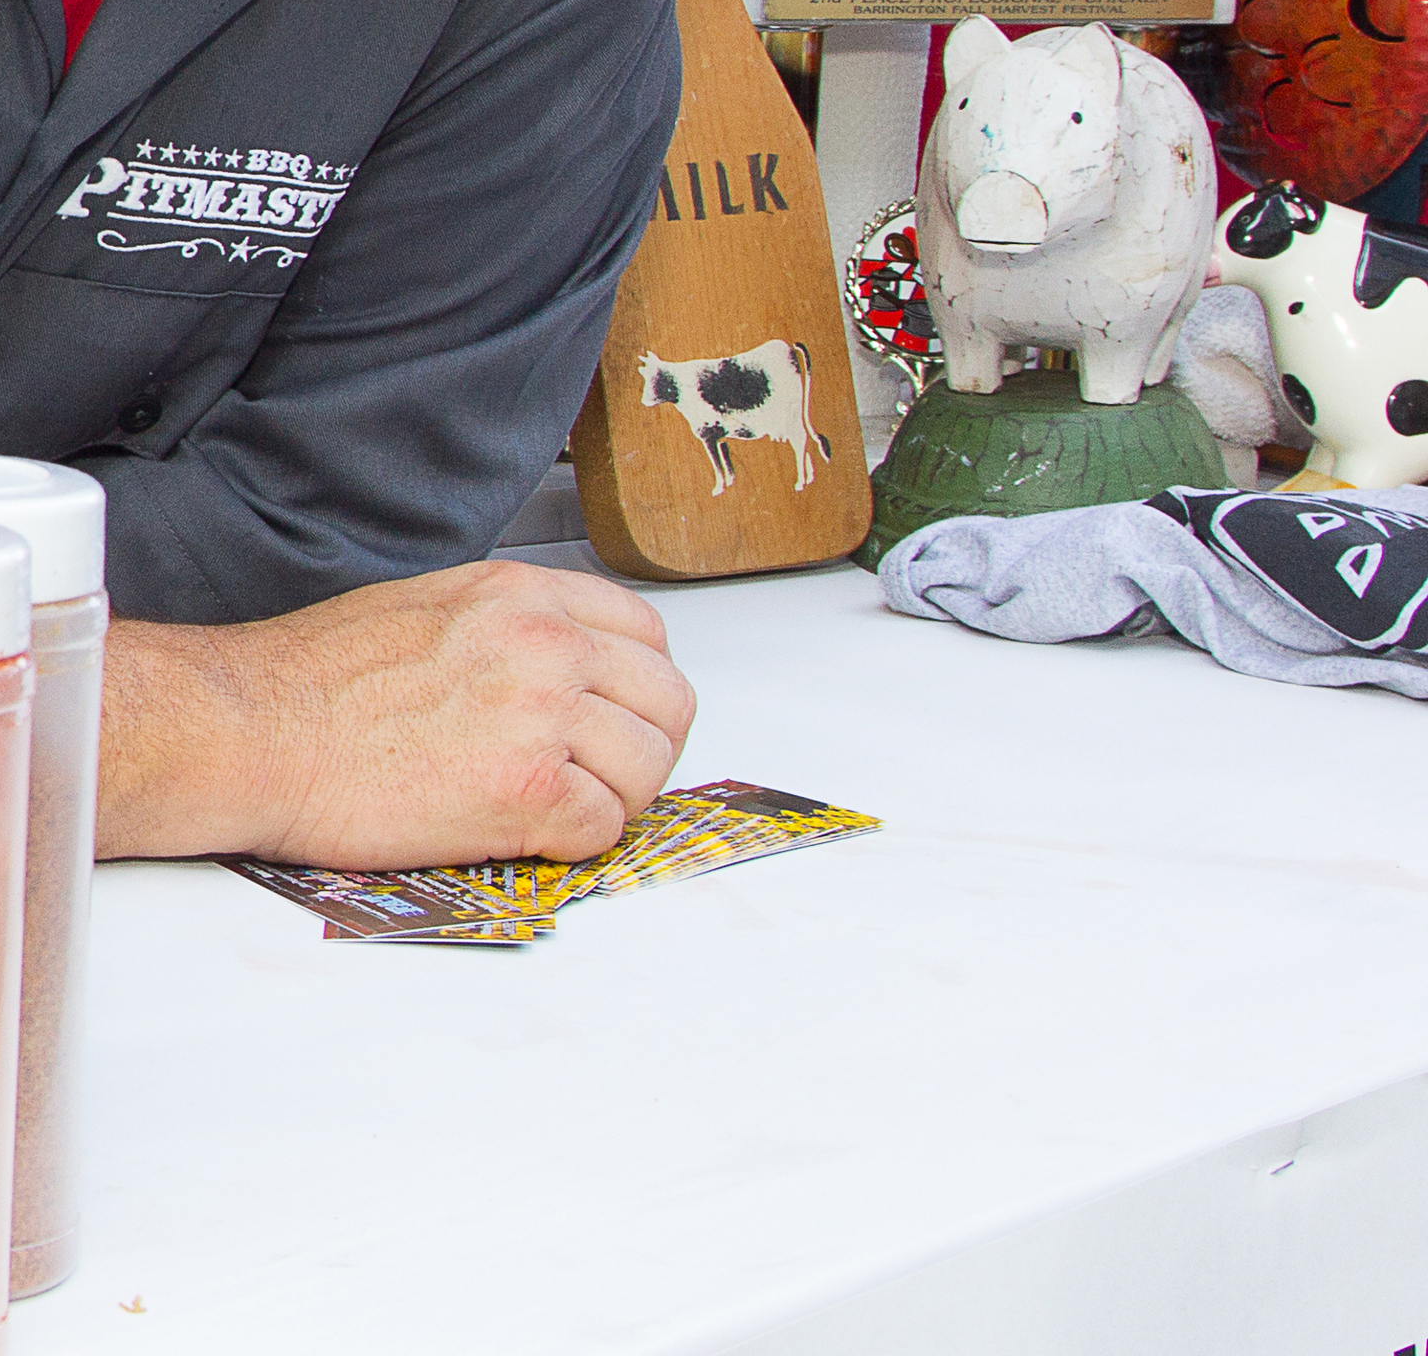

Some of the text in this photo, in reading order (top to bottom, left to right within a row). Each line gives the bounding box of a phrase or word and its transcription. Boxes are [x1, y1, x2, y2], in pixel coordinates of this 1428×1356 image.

[852, 5, 1126, 14] BARRINGTON FALL HARVEST FESTIVAL
[244, 148, 313, 181] BBQ
